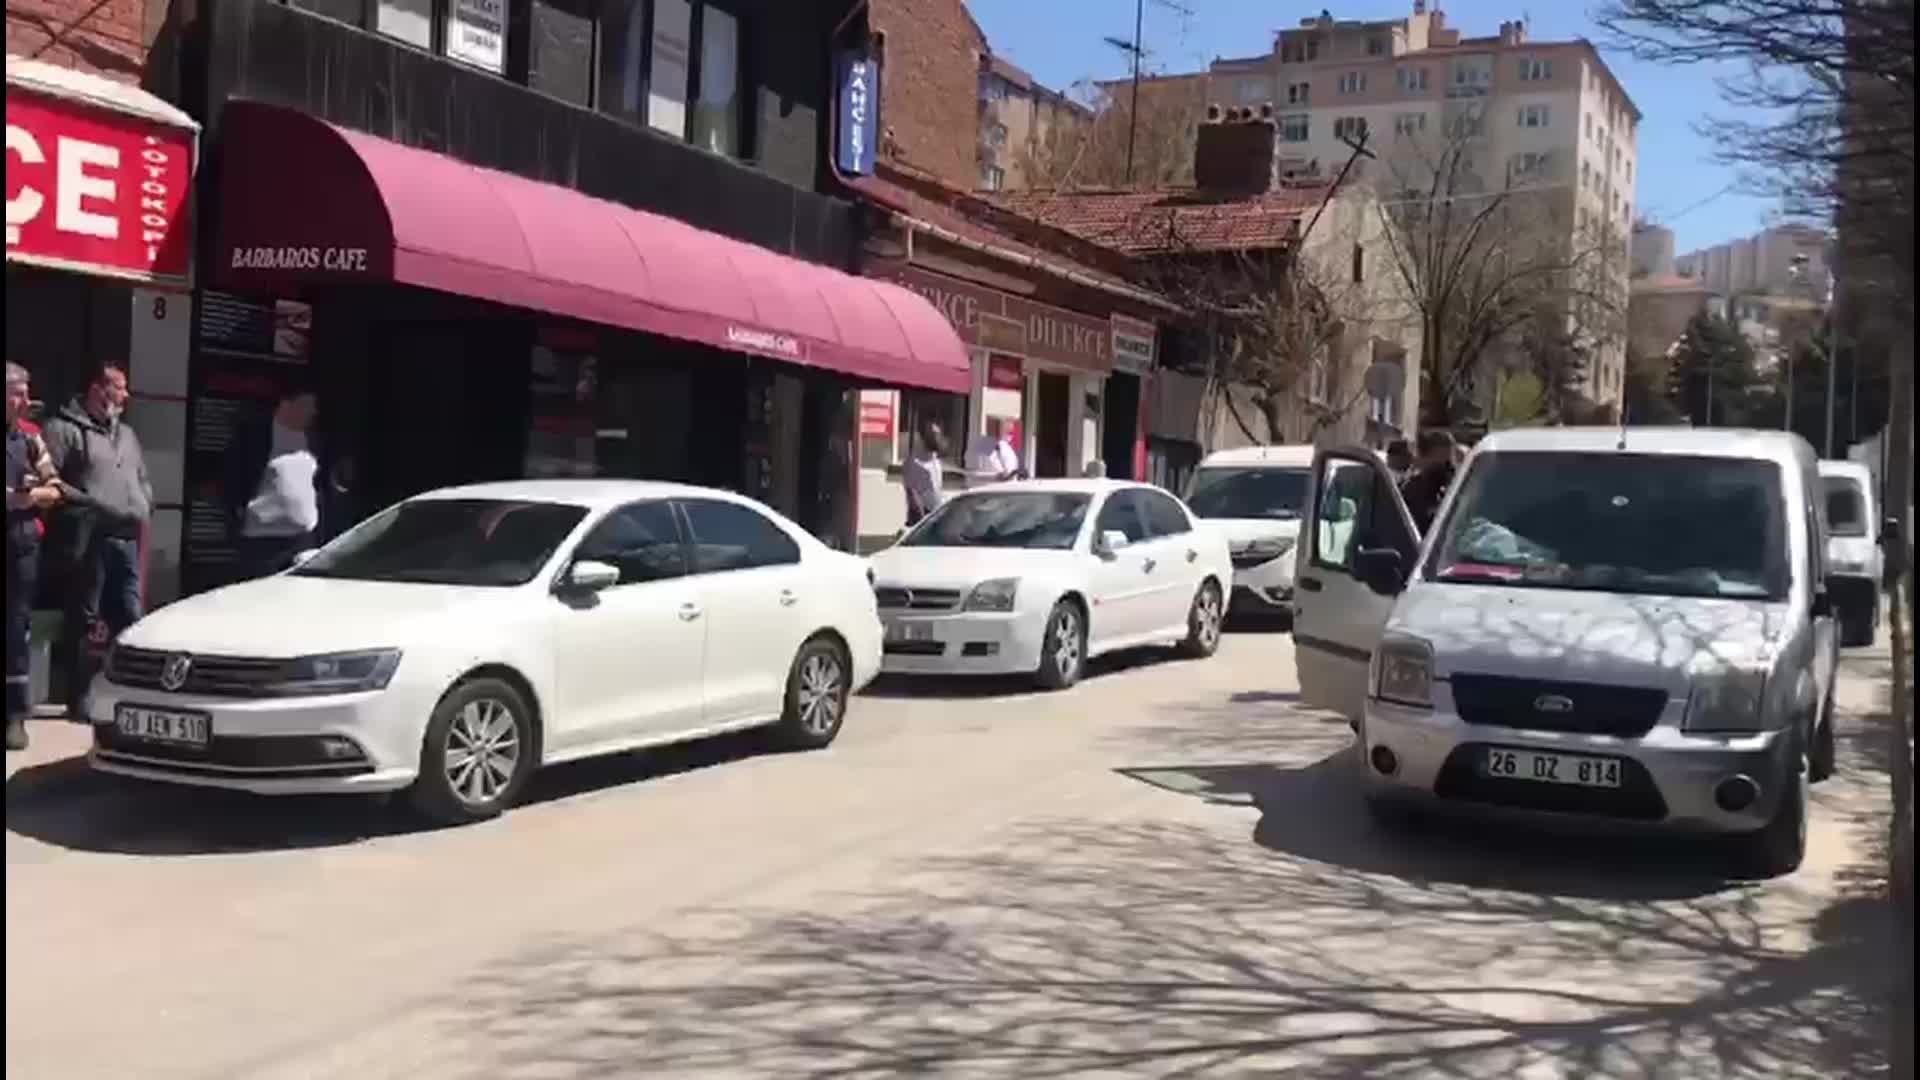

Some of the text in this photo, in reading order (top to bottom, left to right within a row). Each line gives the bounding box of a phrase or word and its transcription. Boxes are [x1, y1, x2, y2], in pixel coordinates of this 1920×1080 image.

[231, 247, 368, 271] BARBAROS CAFE
[152, 297, 167, 321] 8
[1491, 751, 1517, 775] 26
[1533, 755, 1560, 780] DZ
